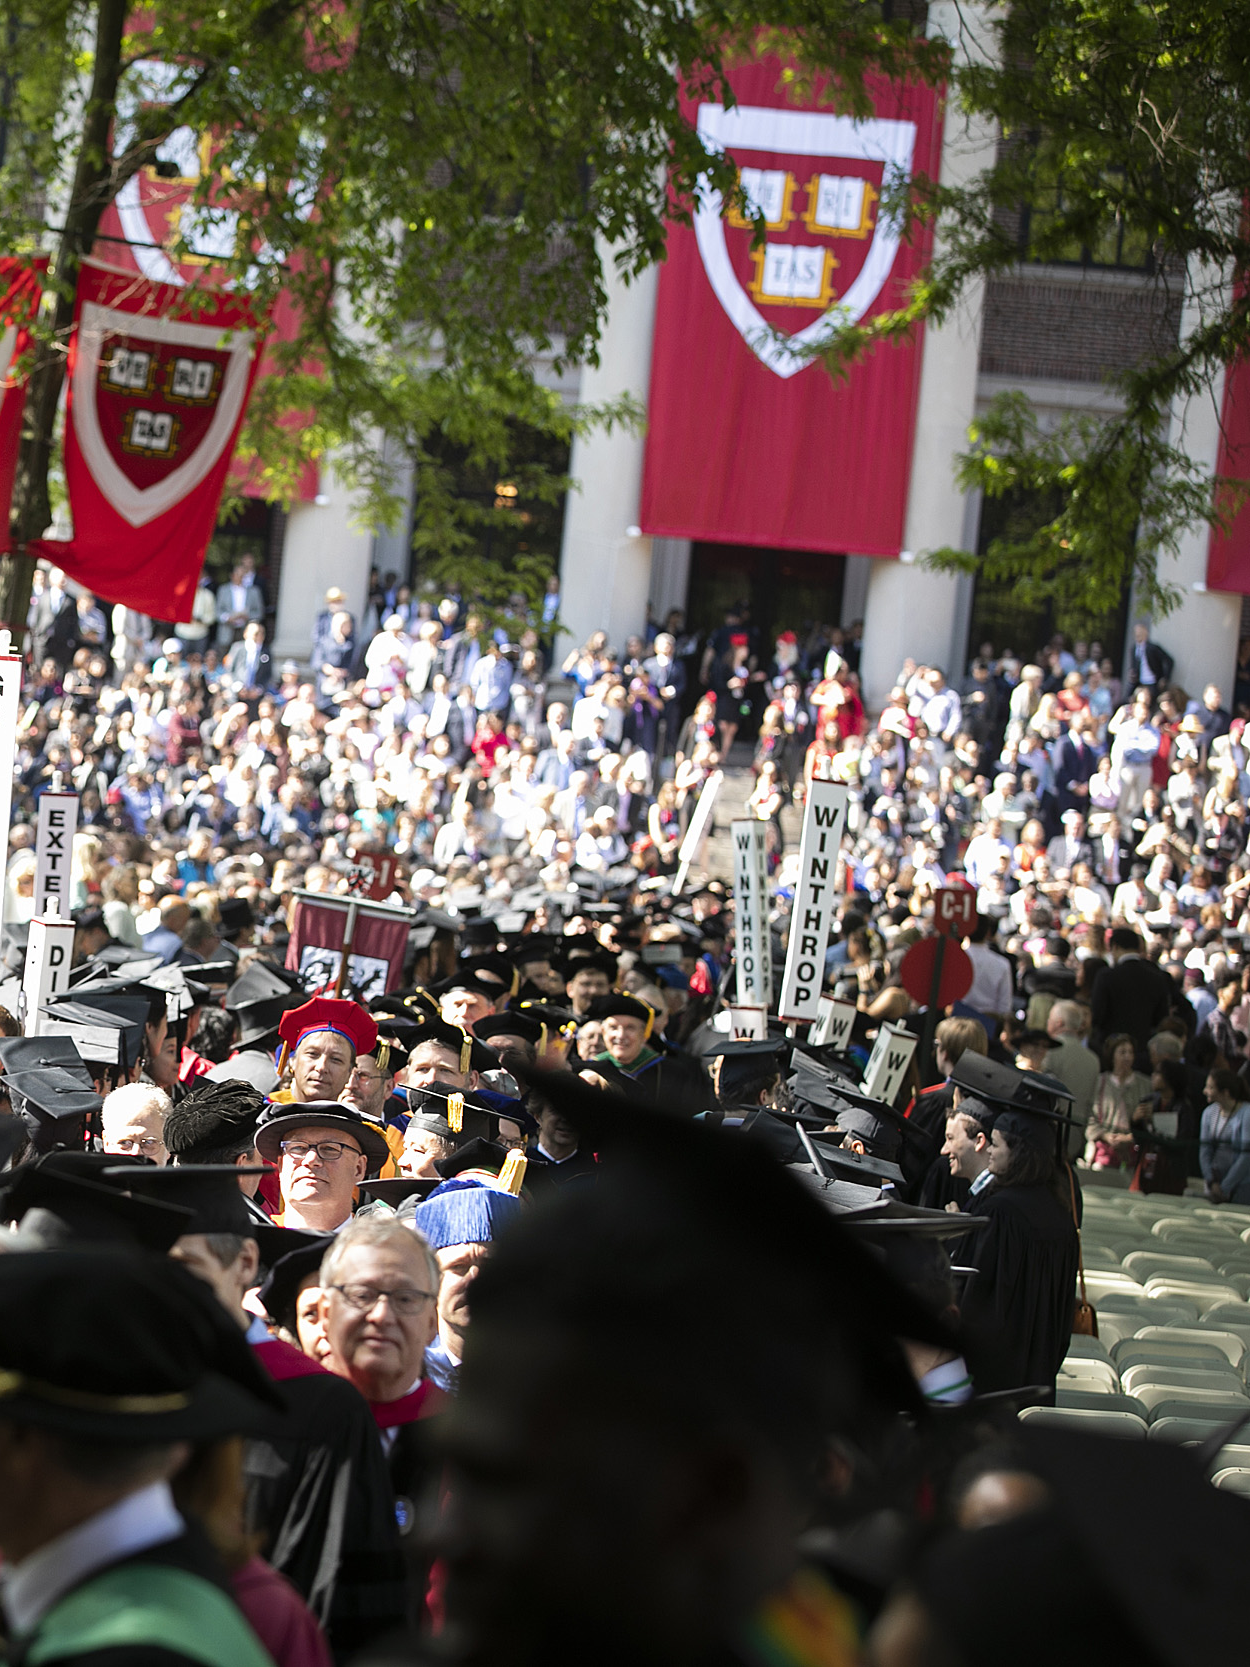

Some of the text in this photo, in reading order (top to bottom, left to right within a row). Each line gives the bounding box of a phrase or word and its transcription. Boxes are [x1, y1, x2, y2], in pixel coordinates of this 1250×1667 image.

[736, 833, 755, 992] WINTHROP
[793, 805, 839, 1007] WINTHROP
[941, 890, 971, 922] C-1
[876, 1051, 907, 1103] WI
